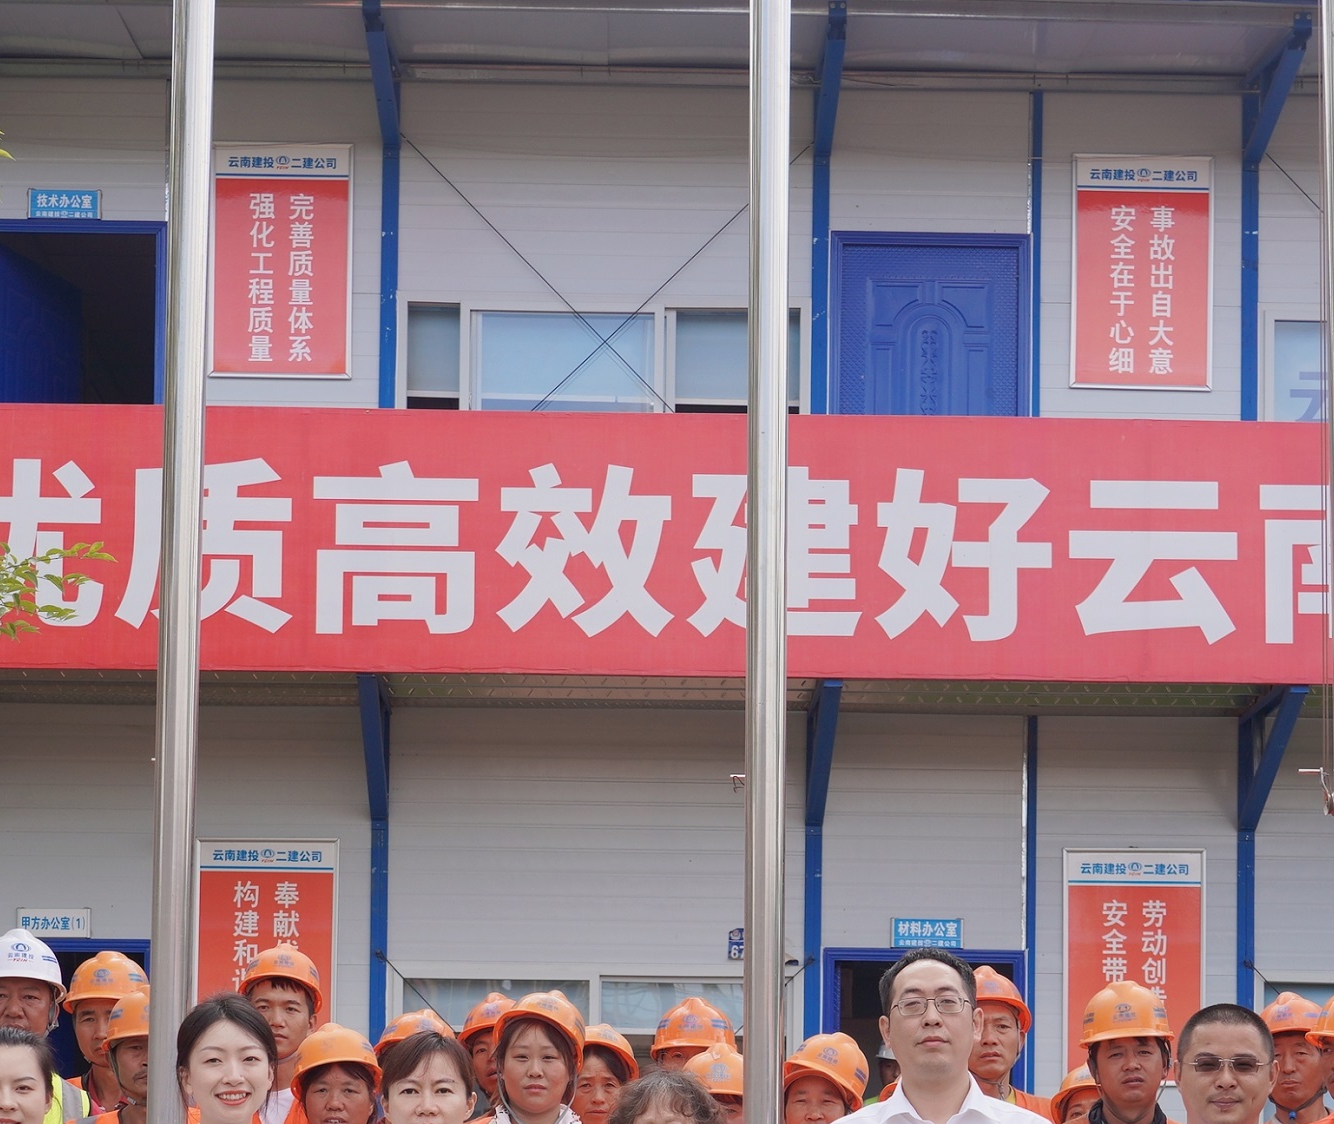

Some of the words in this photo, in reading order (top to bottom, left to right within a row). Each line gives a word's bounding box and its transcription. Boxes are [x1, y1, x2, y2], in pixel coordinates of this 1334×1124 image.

[228, 156, 274, 169] 云南建投
[291, 157, 337, 170] 二建公司
[1090, 168, 1135, 181] 云南建投
[1152, 170, 1198, 182] 二建公司
[37, 194, 93, 209] 技术办公室
[248, 193, 275, 362] 强化工程质量
[288, 193, 315, 362] 完善质量体系
[1109, 205, 1136, 374] 安全在于心细
[1148, 205, 1175, 375] 事故出自大意
[213, 849, 259, 862] 云南建投
[276, 850, 322, 863] 二建公司
[1080, 863, 1127, 875] 云南建投
[1143, 864, 1189, 876] 二建公司
[898, 921, 957, 937] 材料办公室
